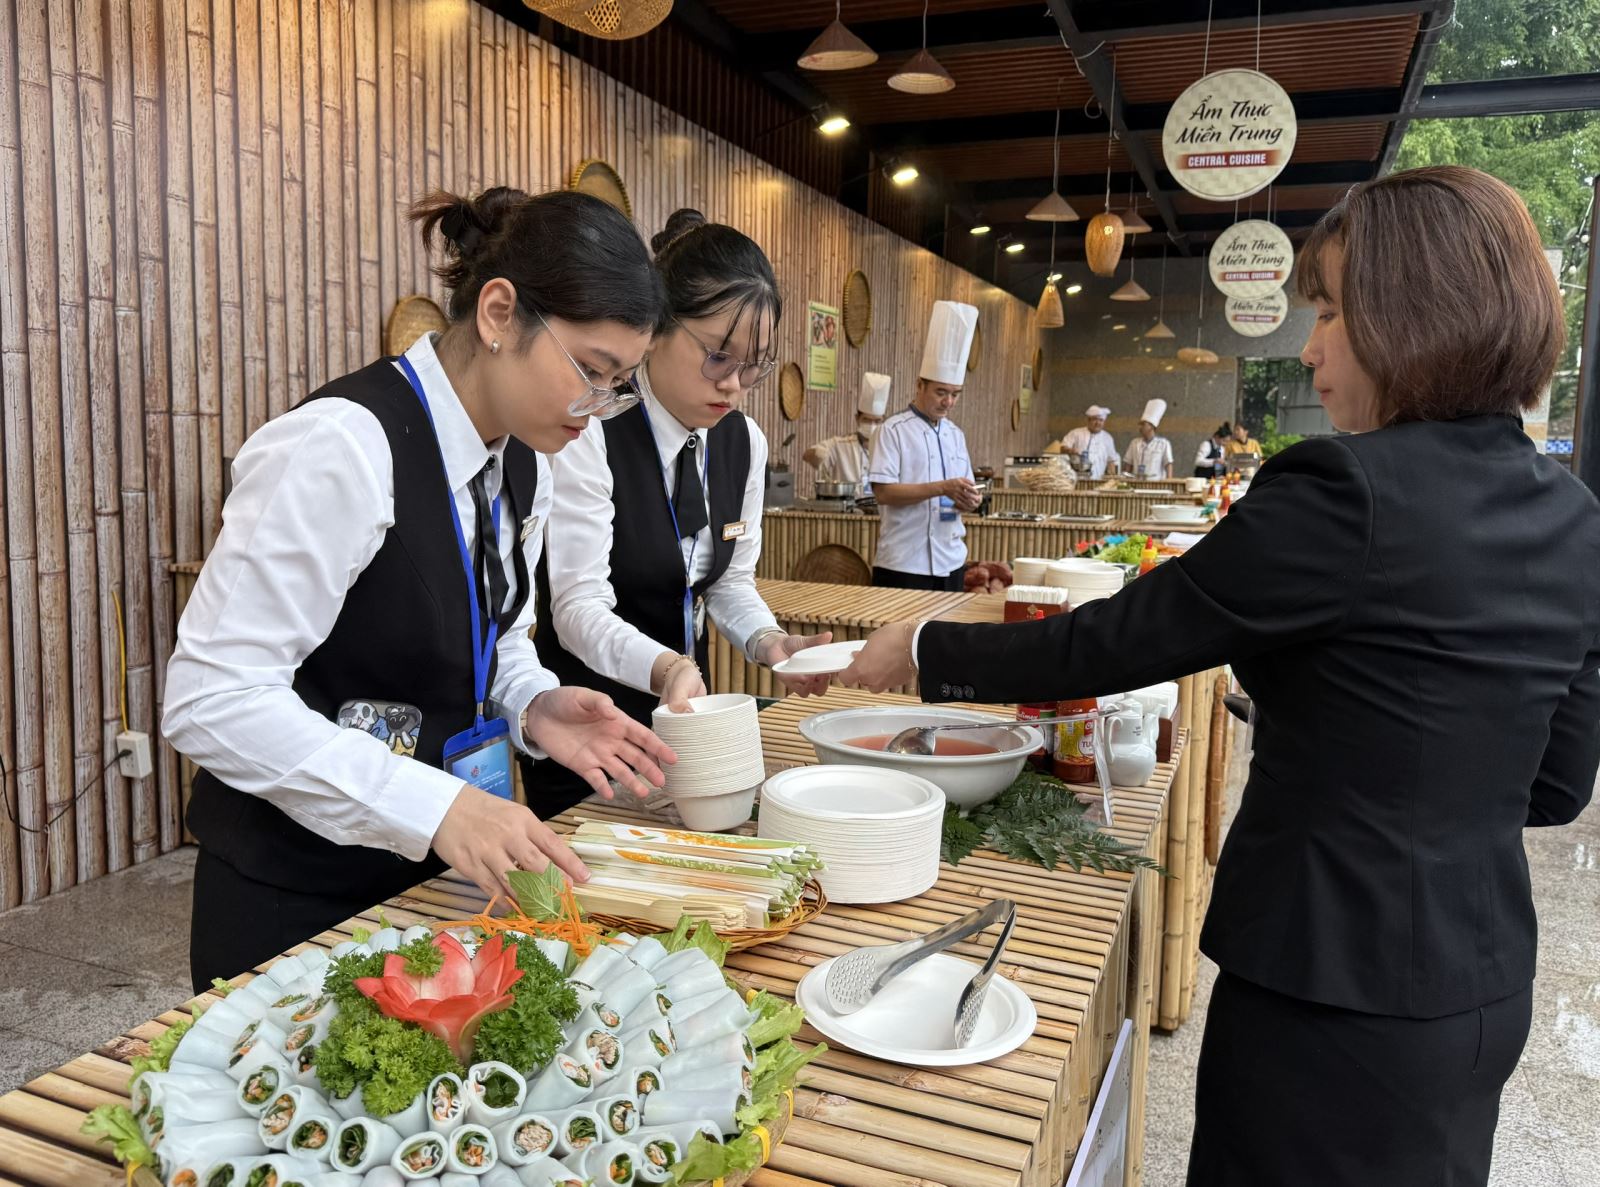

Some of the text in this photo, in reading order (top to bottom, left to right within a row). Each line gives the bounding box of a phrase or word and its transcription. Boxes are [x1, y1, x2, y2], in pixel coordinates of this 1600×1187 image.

[1188, 95, 1273, 121] Ẩm Thực
[1175, 124, 1283, 145] Miền Trung
[1188, 153, 1266, 168] CENTRAL CUISINE
[1250, 254, 1285, 267] Trung
[1225, 272, 1249, 280] CENTRAL
